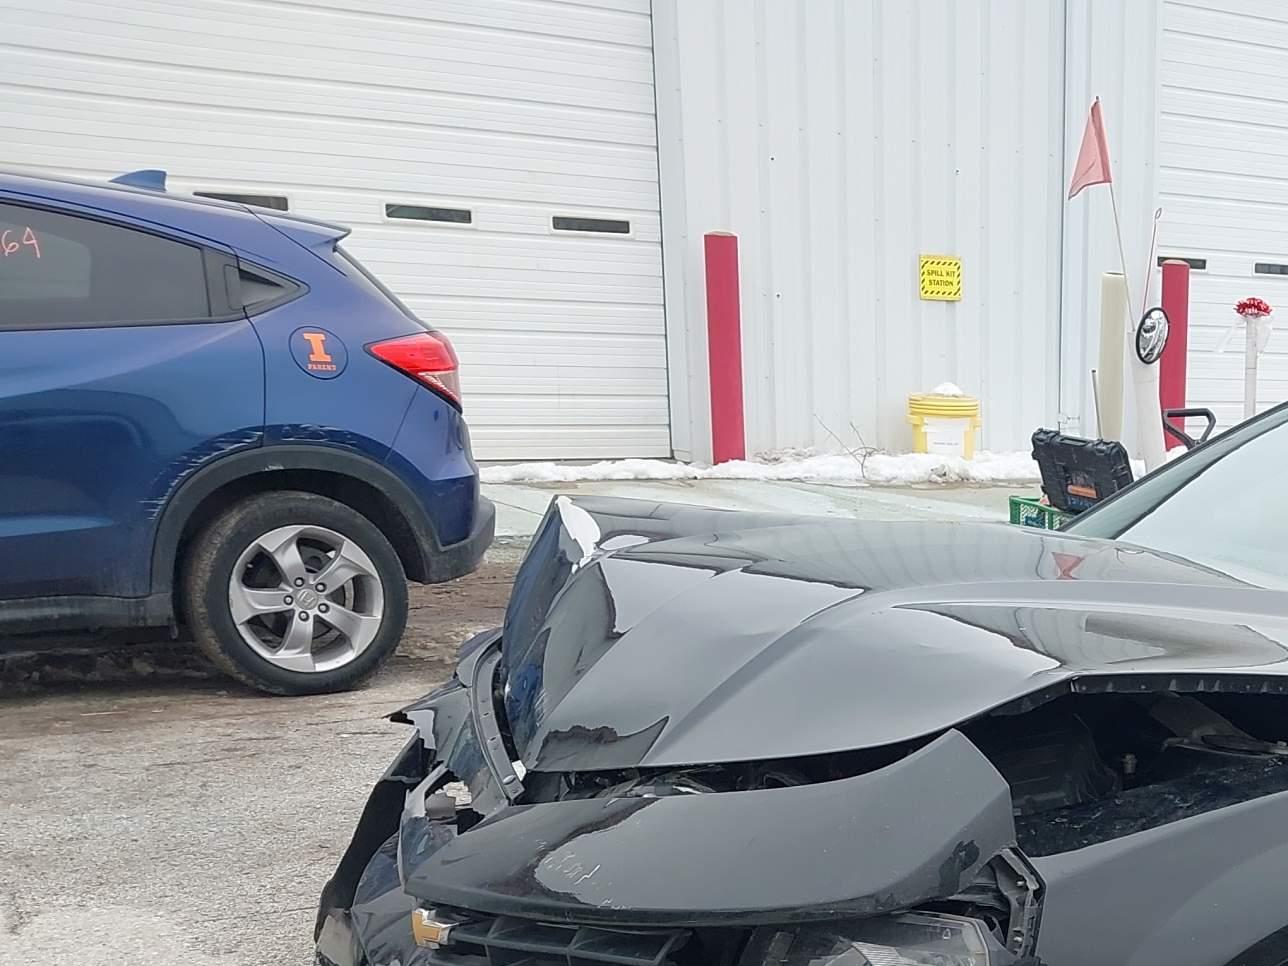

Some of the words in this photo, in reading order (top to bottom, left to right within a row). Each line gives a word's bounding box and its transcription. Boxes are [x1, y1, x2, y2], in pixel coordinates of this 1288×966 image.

[926, 269, 944, 277] SPILL
[945, 270, 956, 278] KIT
[928, 279, 954, 287] STATION
